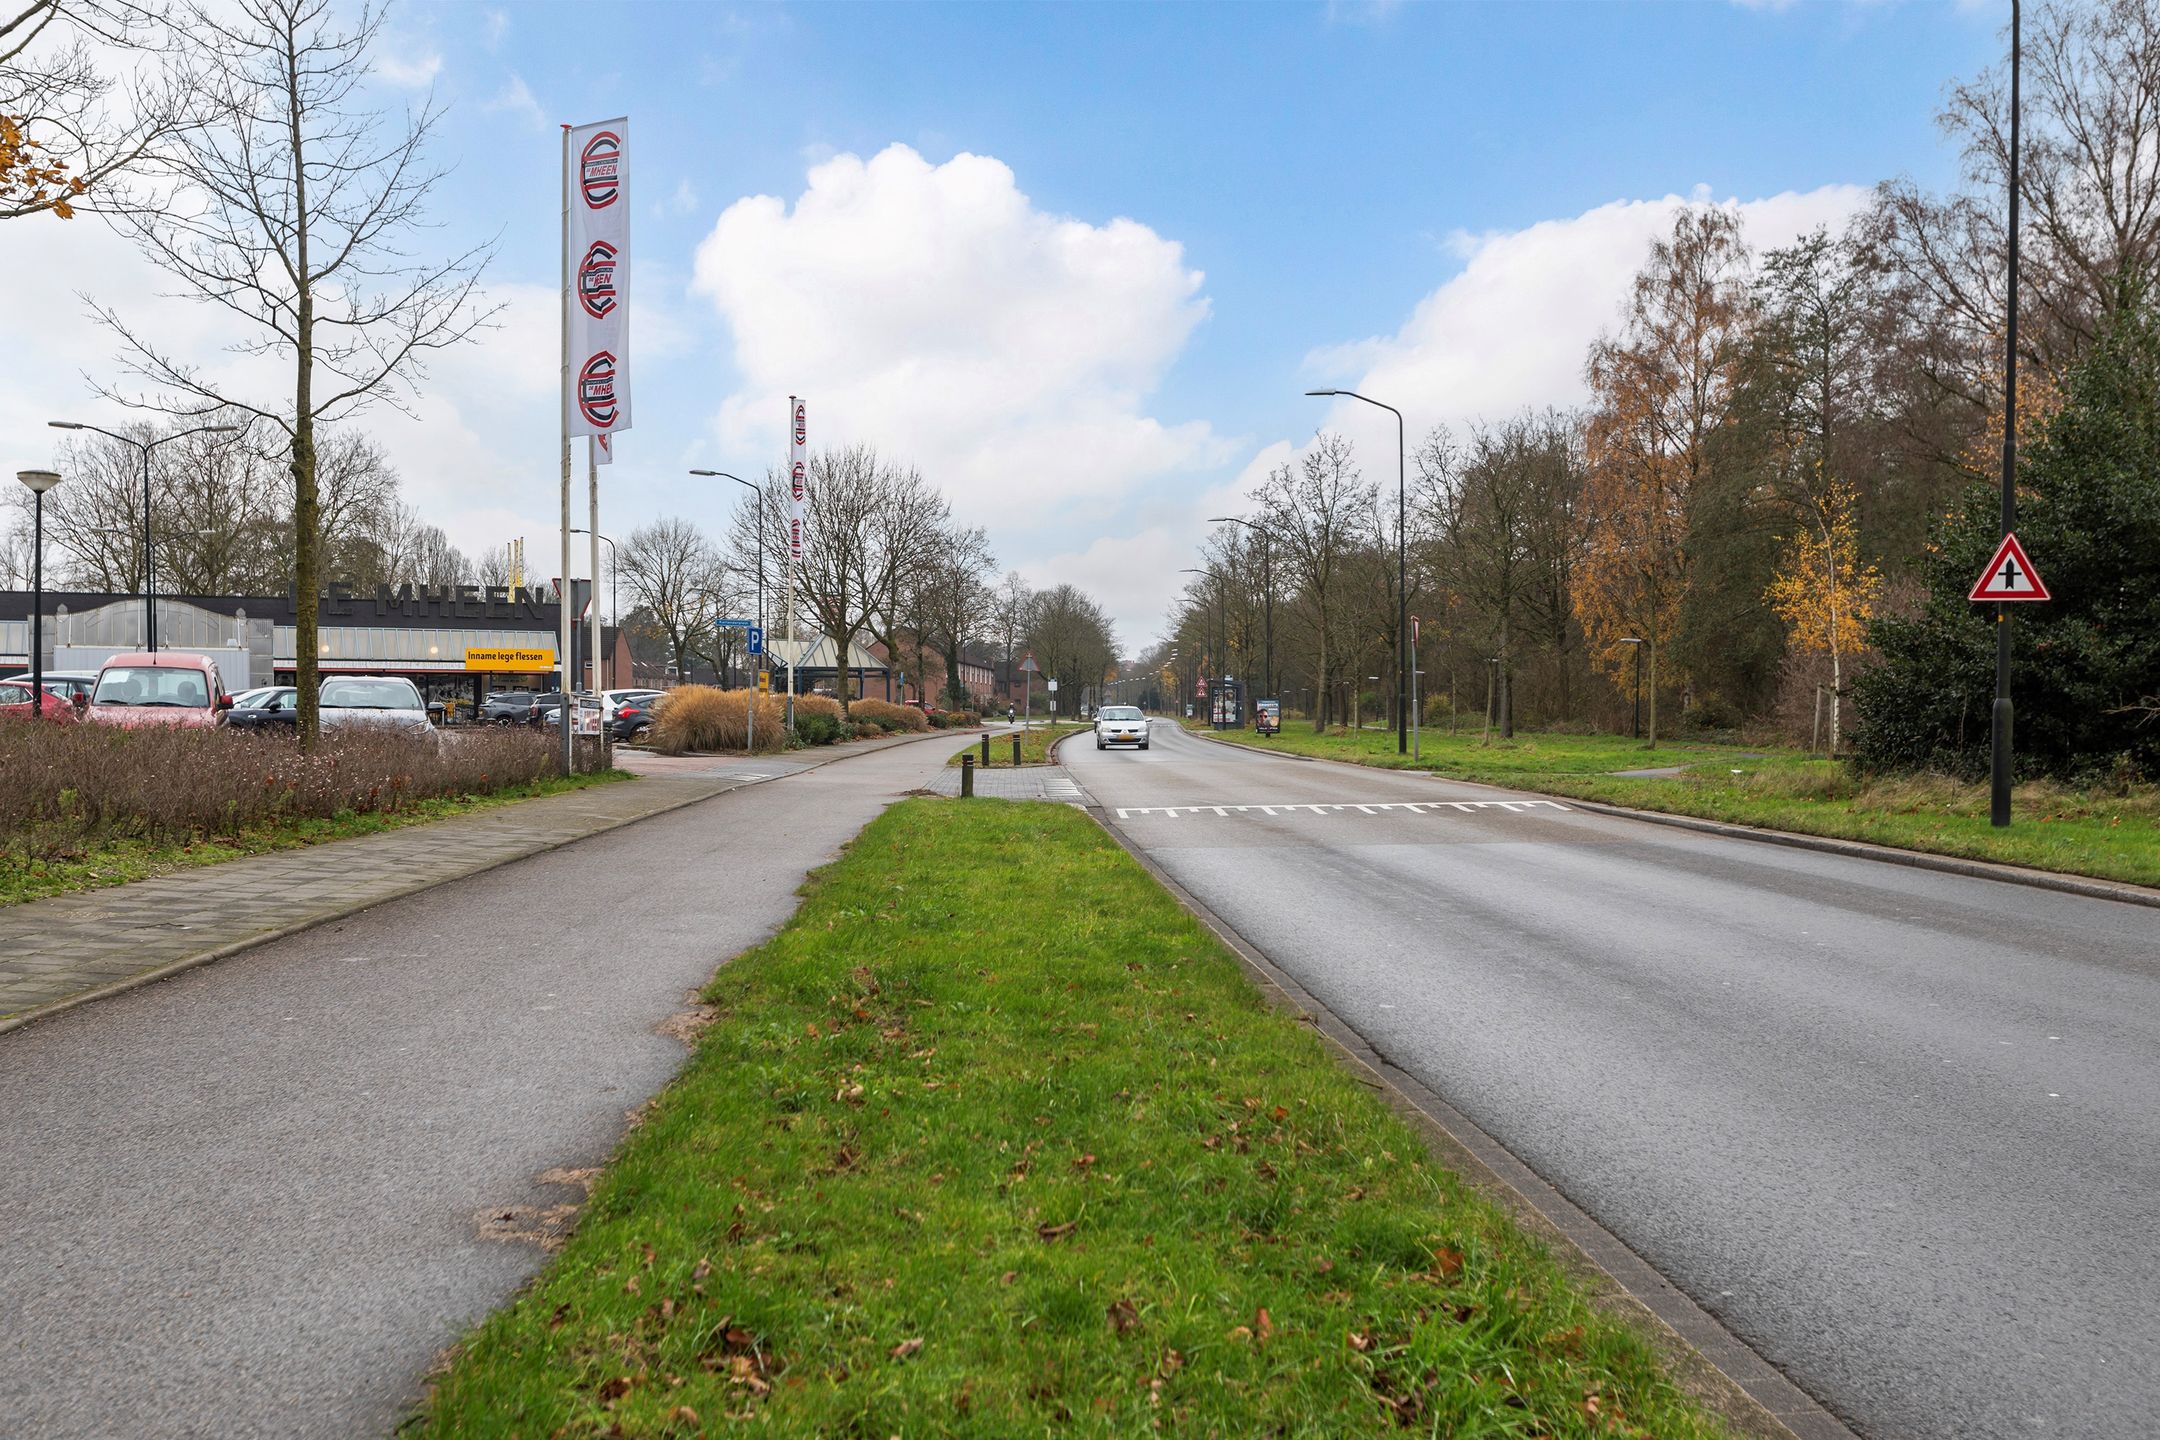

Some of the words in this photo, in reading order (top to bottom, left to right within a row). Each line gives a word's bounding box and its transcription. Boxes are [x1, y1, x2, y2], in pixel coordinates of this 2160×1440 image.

[589, 164, 617, 177] MHEEN
[376, 583, 544, 620] MHEEN
[751, 631, 759, 651] P
[468, 651, 496, 660] Inname
[498, 652, 514, 662] lege
[515, 652, 543, 660] flessen
